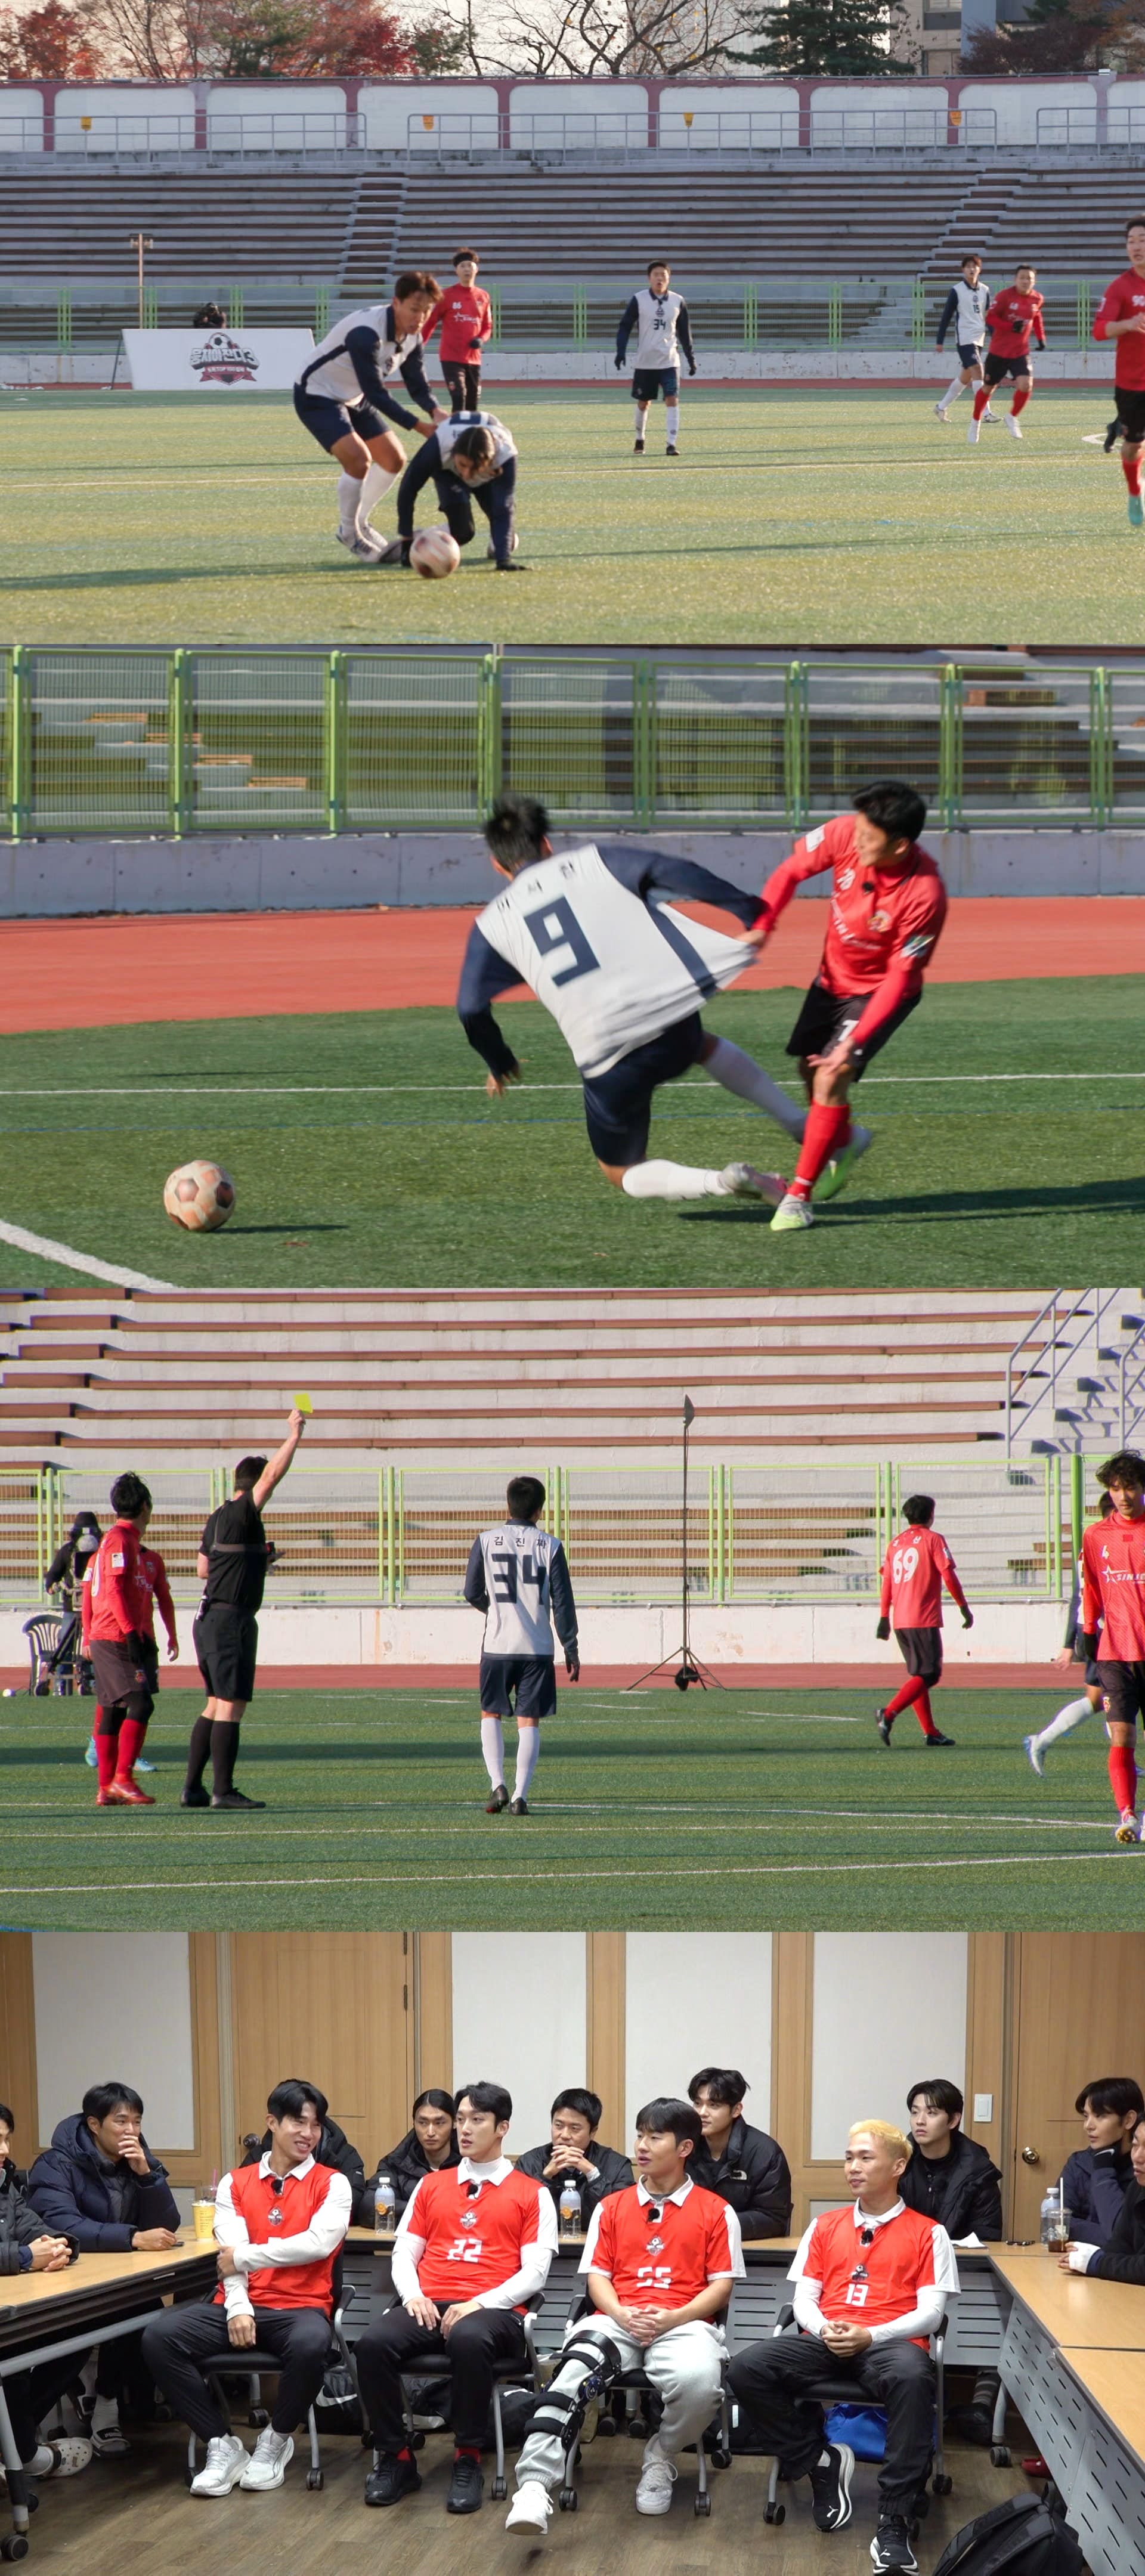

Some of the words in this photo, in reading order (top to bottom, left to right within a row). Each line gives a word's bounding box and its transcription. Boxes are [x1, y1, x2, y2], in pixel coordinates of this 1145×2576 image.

[654, 319, 666, 330] 34
[524, 895, 601, 987] 9
[893, 1547, 919, 1584] 69
[491, 1553, 547, 1605] 34
[447, 2237, 482, 2263] 22
[636, 2267, 672, 2289] 55
[845, 2283, 869, 2306] 13
